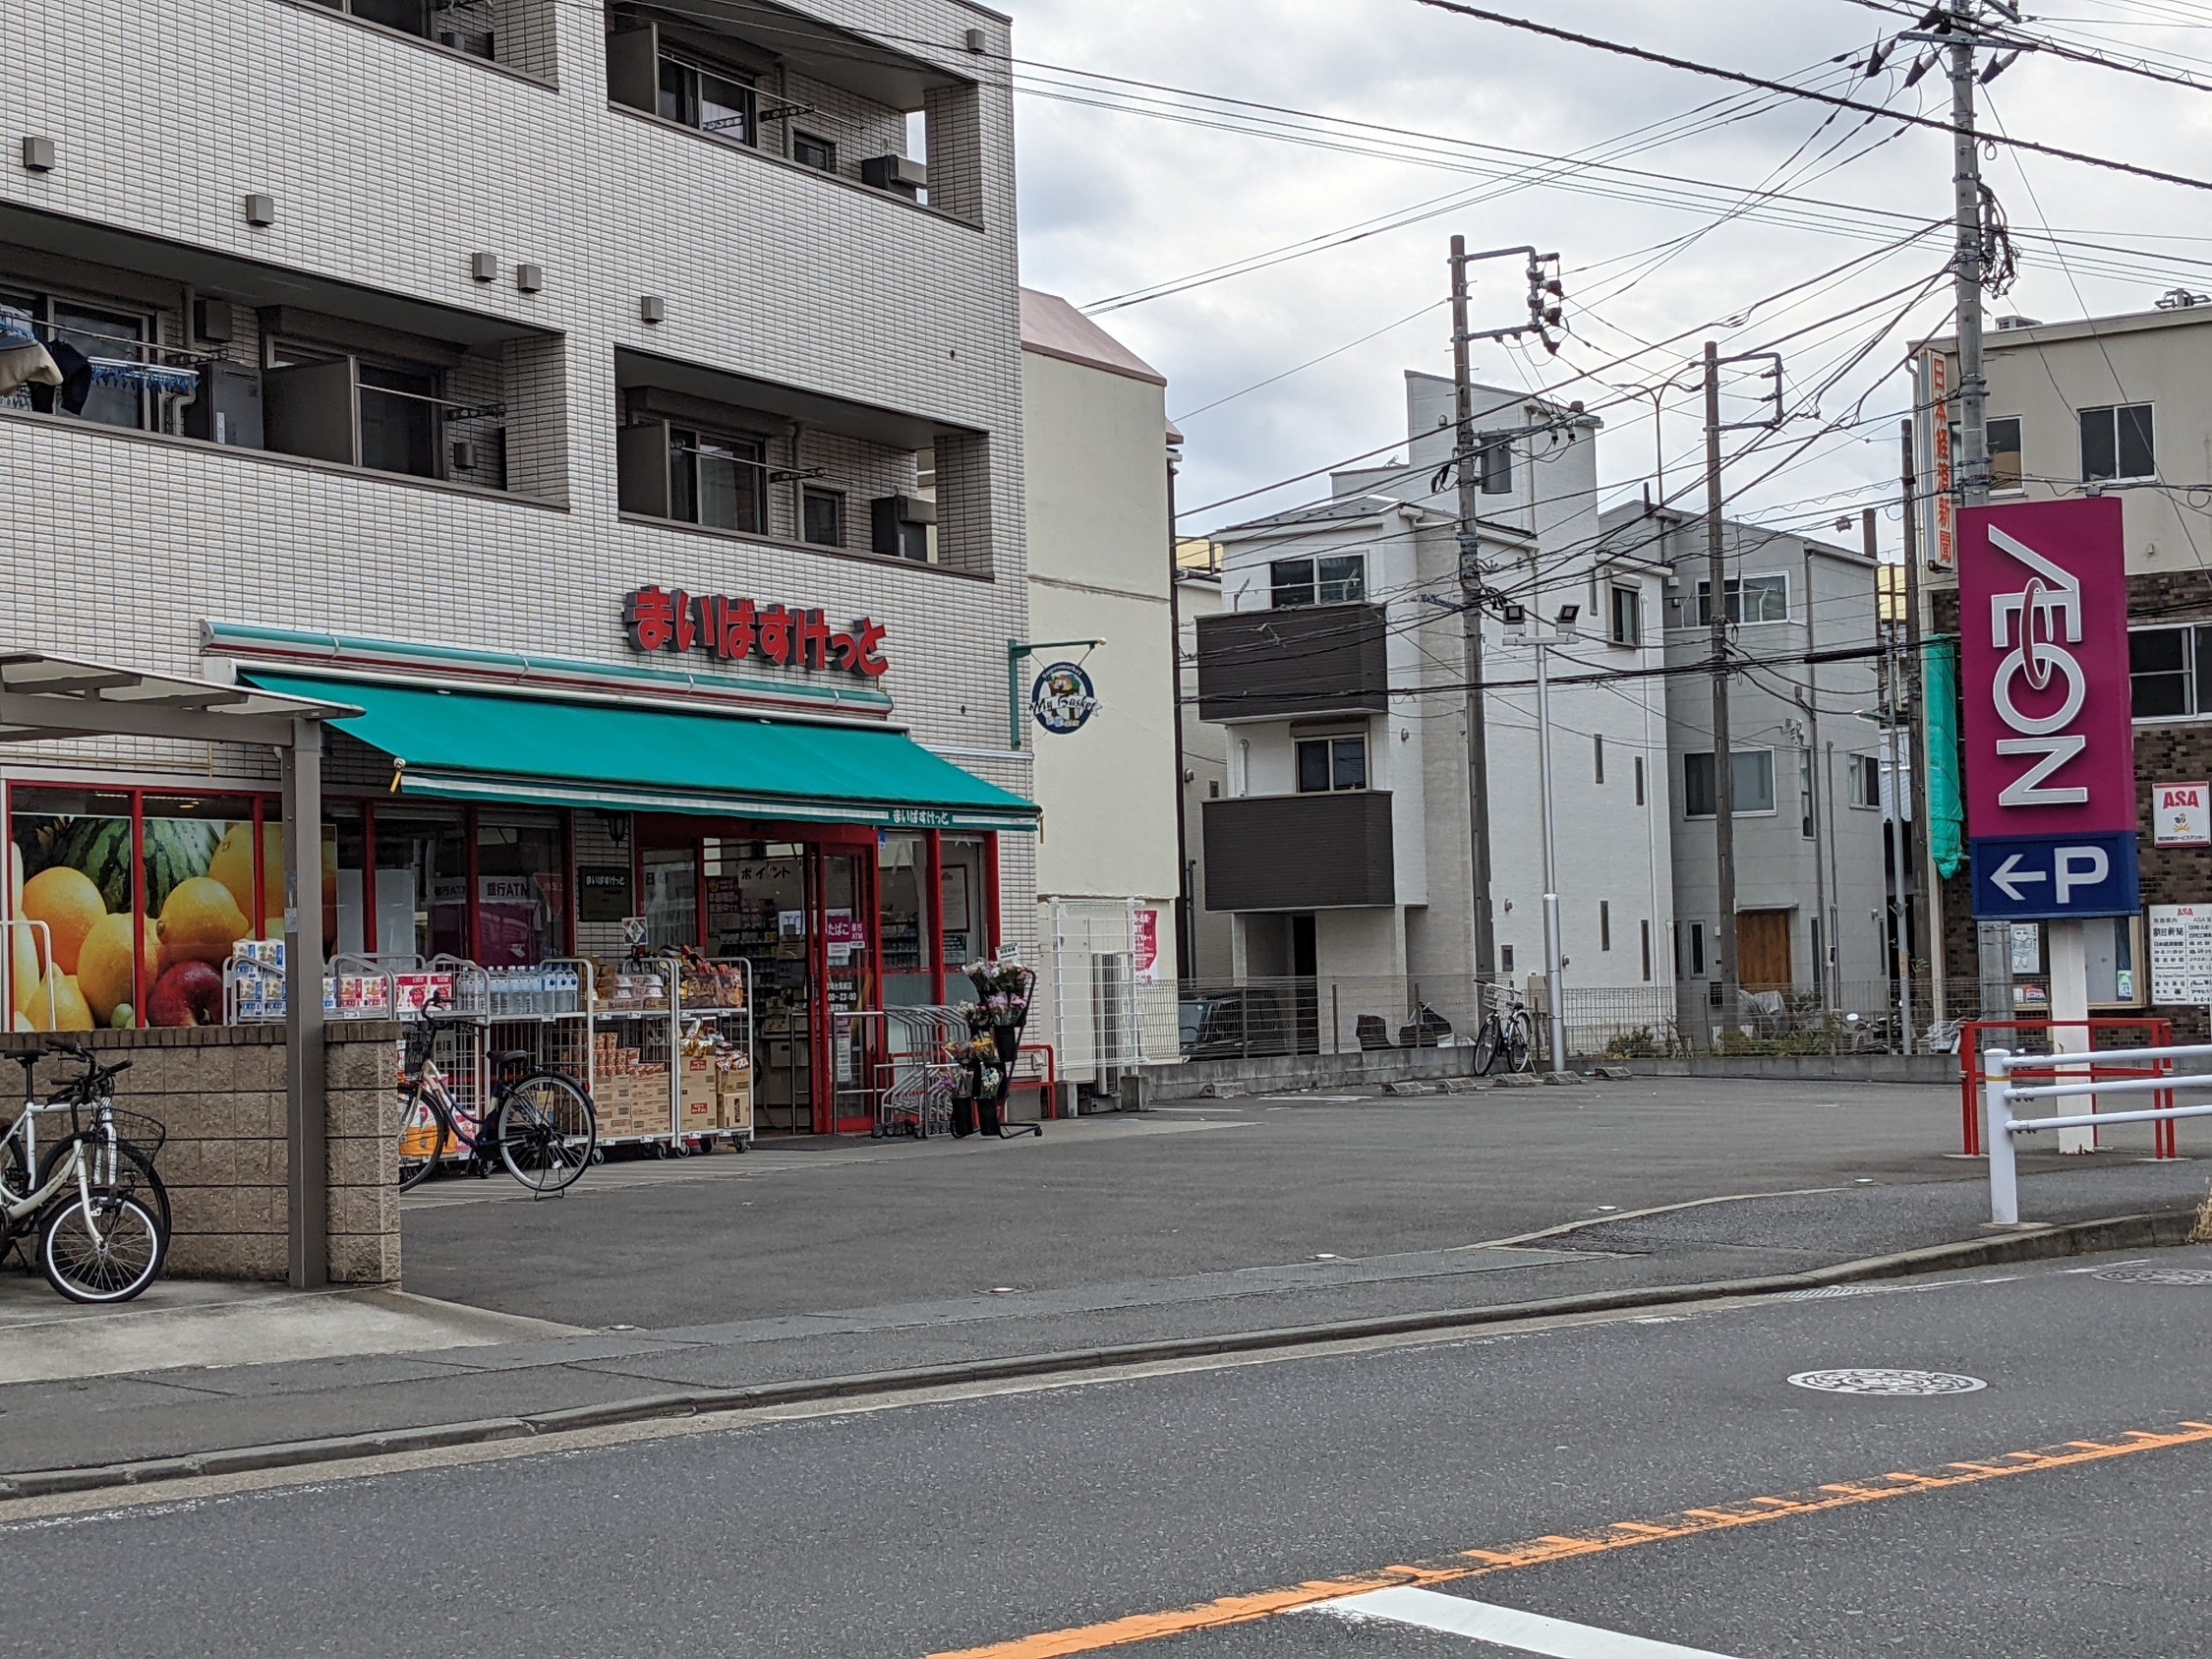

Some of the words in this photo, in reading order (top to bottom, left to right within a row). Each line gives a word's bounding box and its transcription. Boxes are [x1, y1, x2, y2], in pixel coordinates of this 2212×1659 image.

[1934, 358, 1951, 563] 日本経済新聞
[624, 584, 890, 677] まいばすけっと
[1029, 698, 1053, 716] My
[2163, 791, 2200, 809] ASA
[893, 808, 950, 825] まいばすけっと
[741, 865, 790, 880] ポイント
[2054, 846, 2110, 904] P
[2177, 908, 2193, 917] ASA
[828, 922, 849, 936] たばこ
